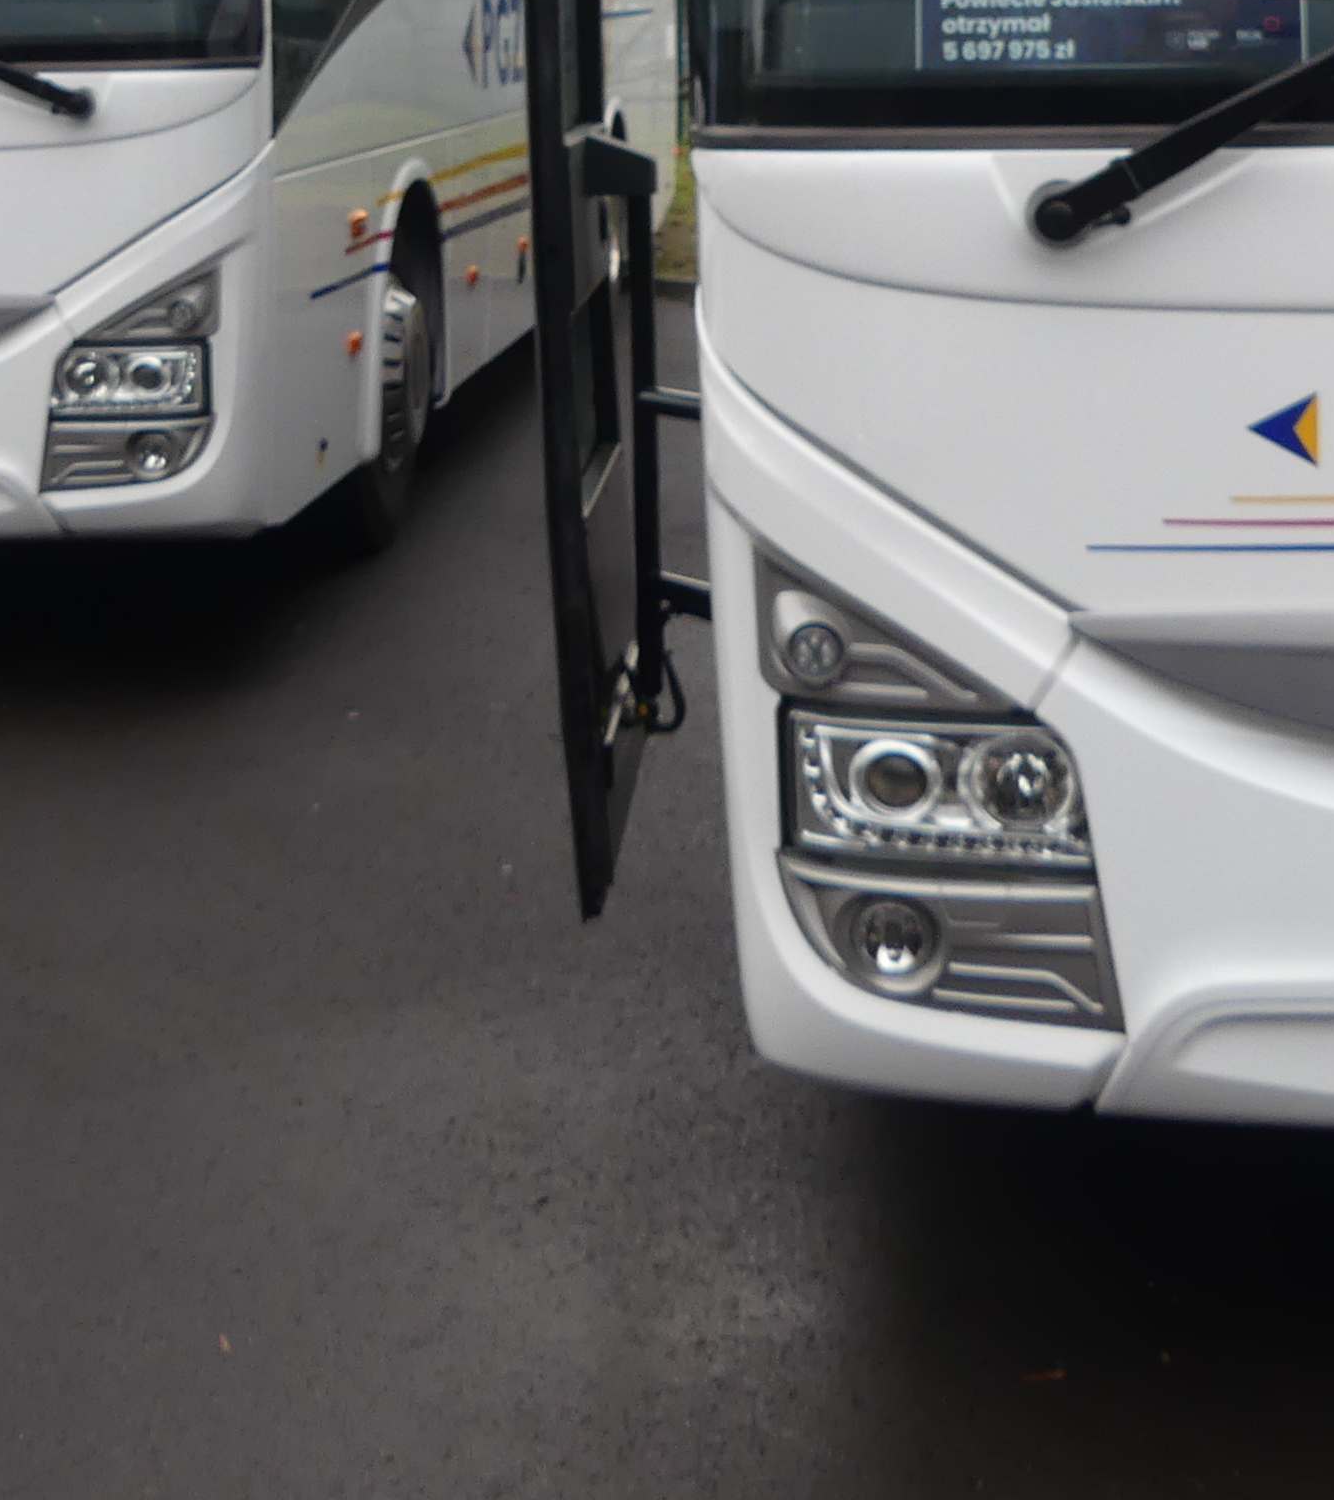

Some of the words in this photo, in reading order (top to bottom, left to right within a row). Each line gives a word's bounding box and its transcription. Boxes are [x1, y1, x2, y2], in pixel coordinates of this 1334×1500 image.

[941, 12, 1052, 39] otrzymał
[943, 41, 959, 62] 5
[962, 40, 1004, 61] 697
[1008, 39, 1052, 61] 975
[1054, 38, 1077, 60] zł
